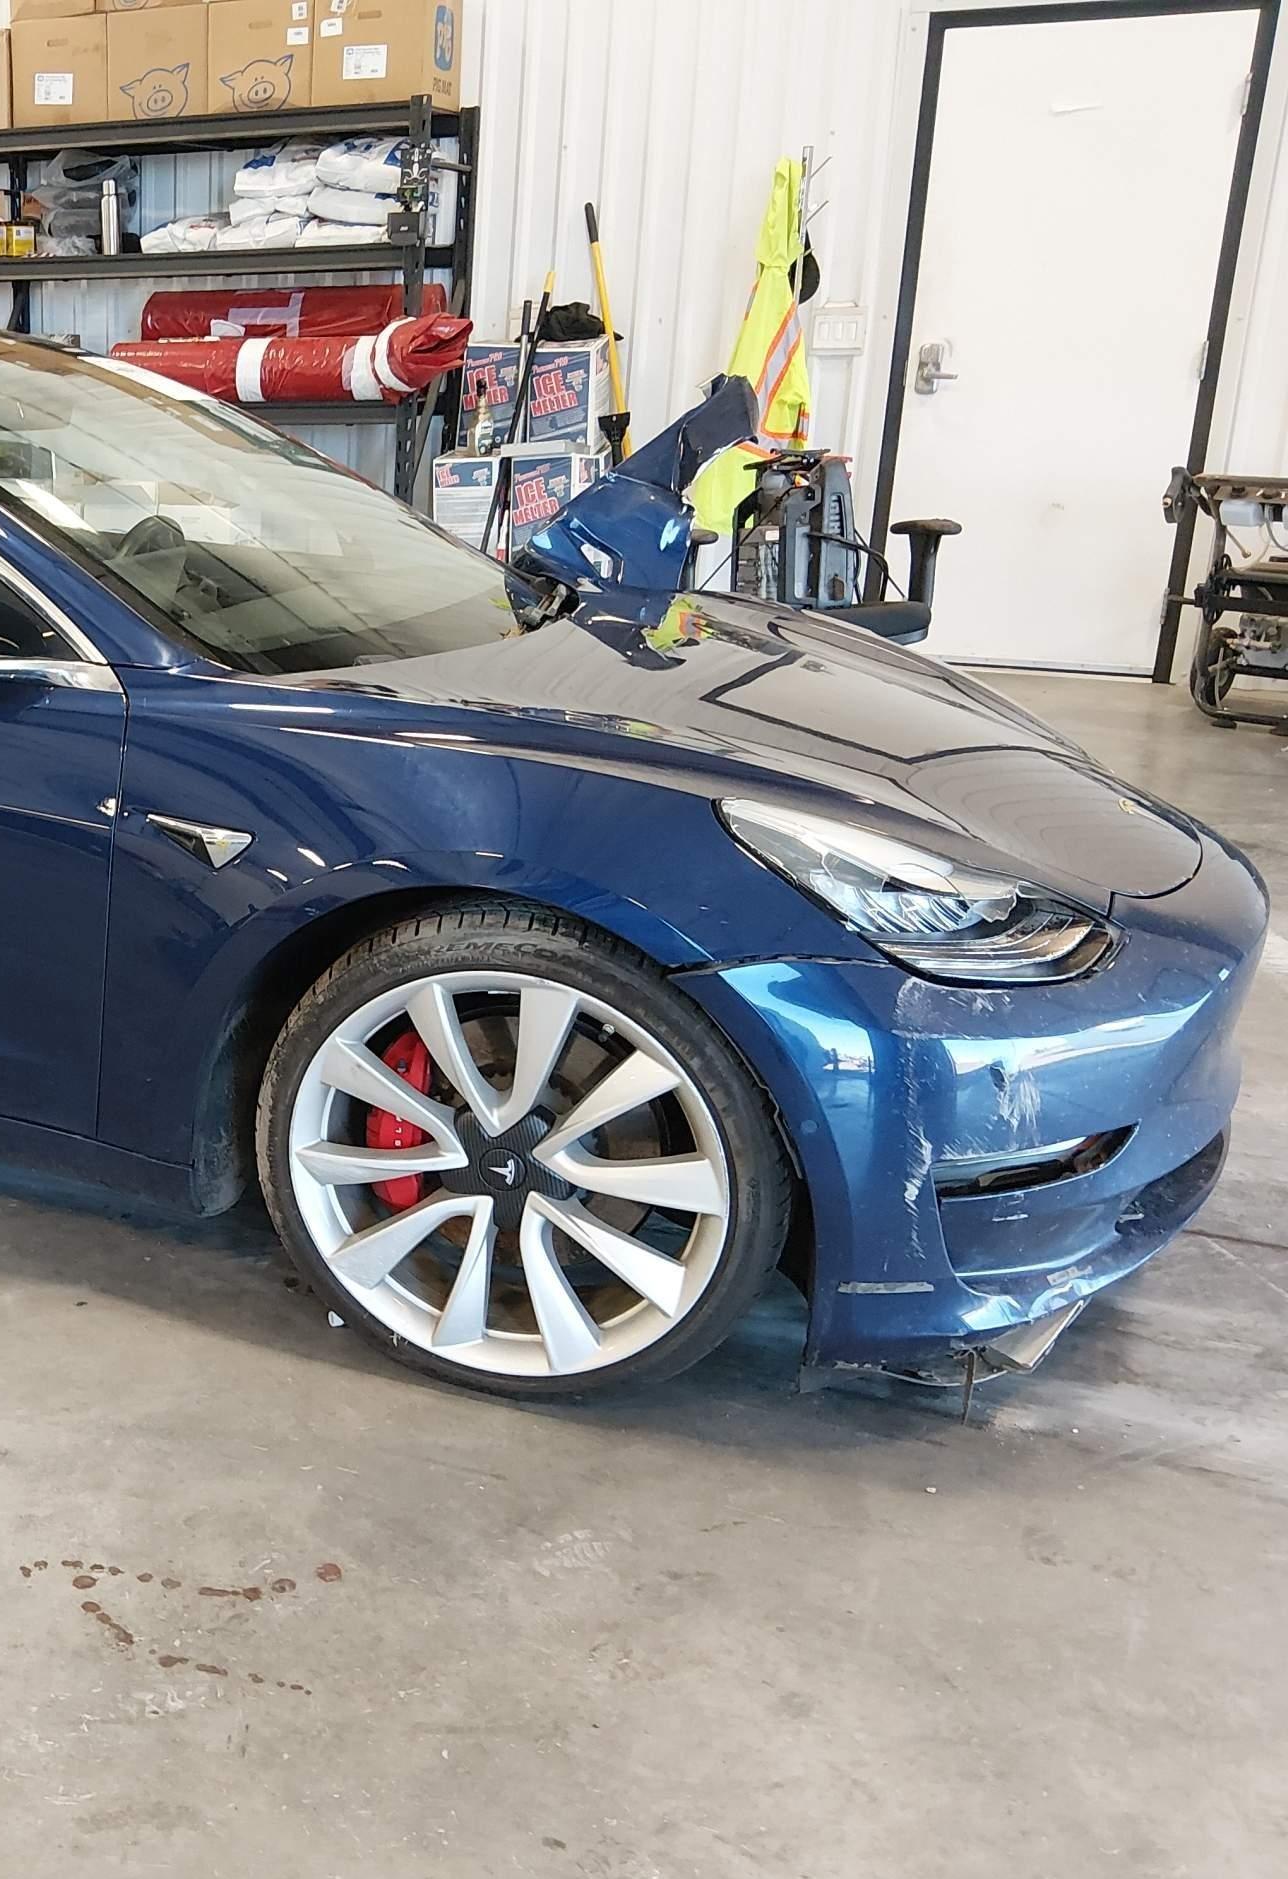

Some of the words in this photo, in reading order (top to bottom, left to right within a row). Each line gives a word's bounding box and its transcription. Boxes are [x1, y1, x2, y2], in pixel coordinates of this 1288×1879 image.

[463, 385, 509, 411] MTER
[533, 370, 565, 399] ICE
[530, 391, 579, 417] MELTER
[515, 477, 547, 509] ICE
[512, 497, 560, 526] MELTER
